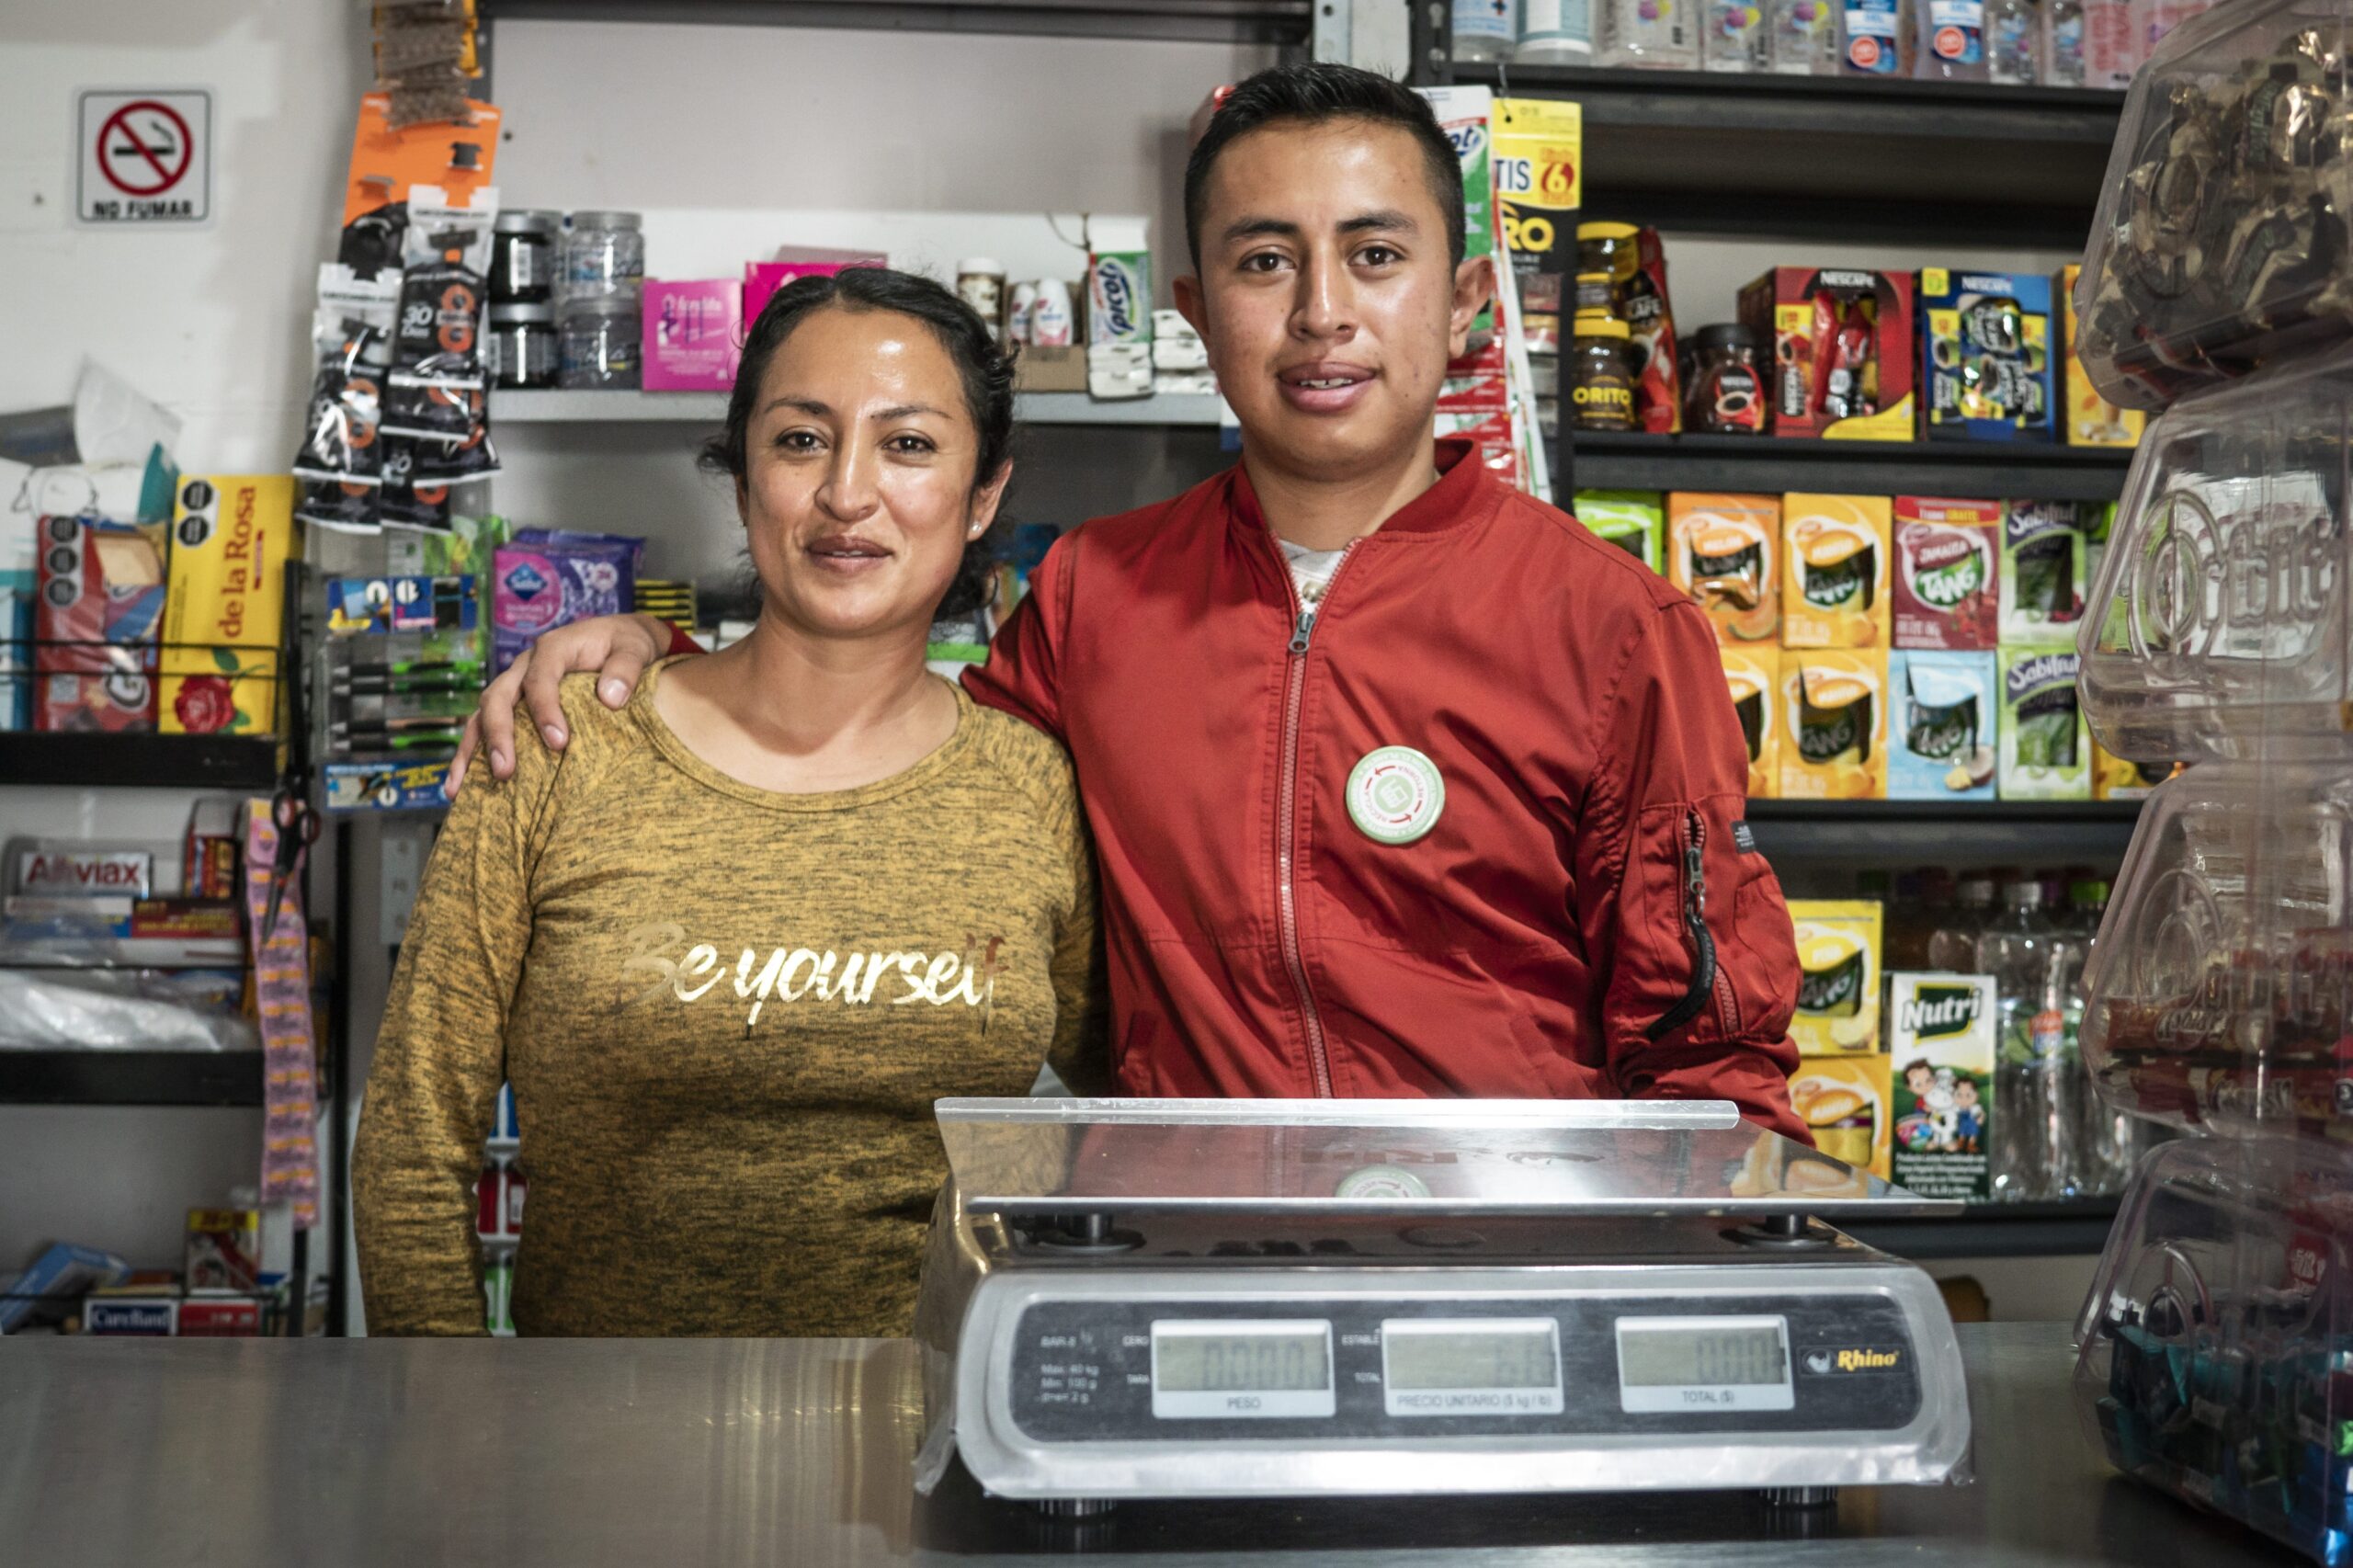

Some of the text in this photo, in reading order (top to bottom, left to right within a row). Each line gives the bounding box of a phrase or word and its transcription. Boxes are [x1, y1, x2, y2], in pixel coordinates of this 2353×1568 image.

[94, 200, 192, 220] NO FUMAR
[218, 486, 256, 639] de la Rosa
[1919, 562, 1976, 604] TANG
[1901, 987, 1984, 1032] Nutri
[1837, 1349, 1895, 1371] Rhino
[1227, 1397, 1261, 1410] PESO
[1397, 1394, 1442, 1407] PRECIO
[1445, 1393, 1500, 1407] UNITARIO
[1682, 1392, 1719, 1403] TOTAL
